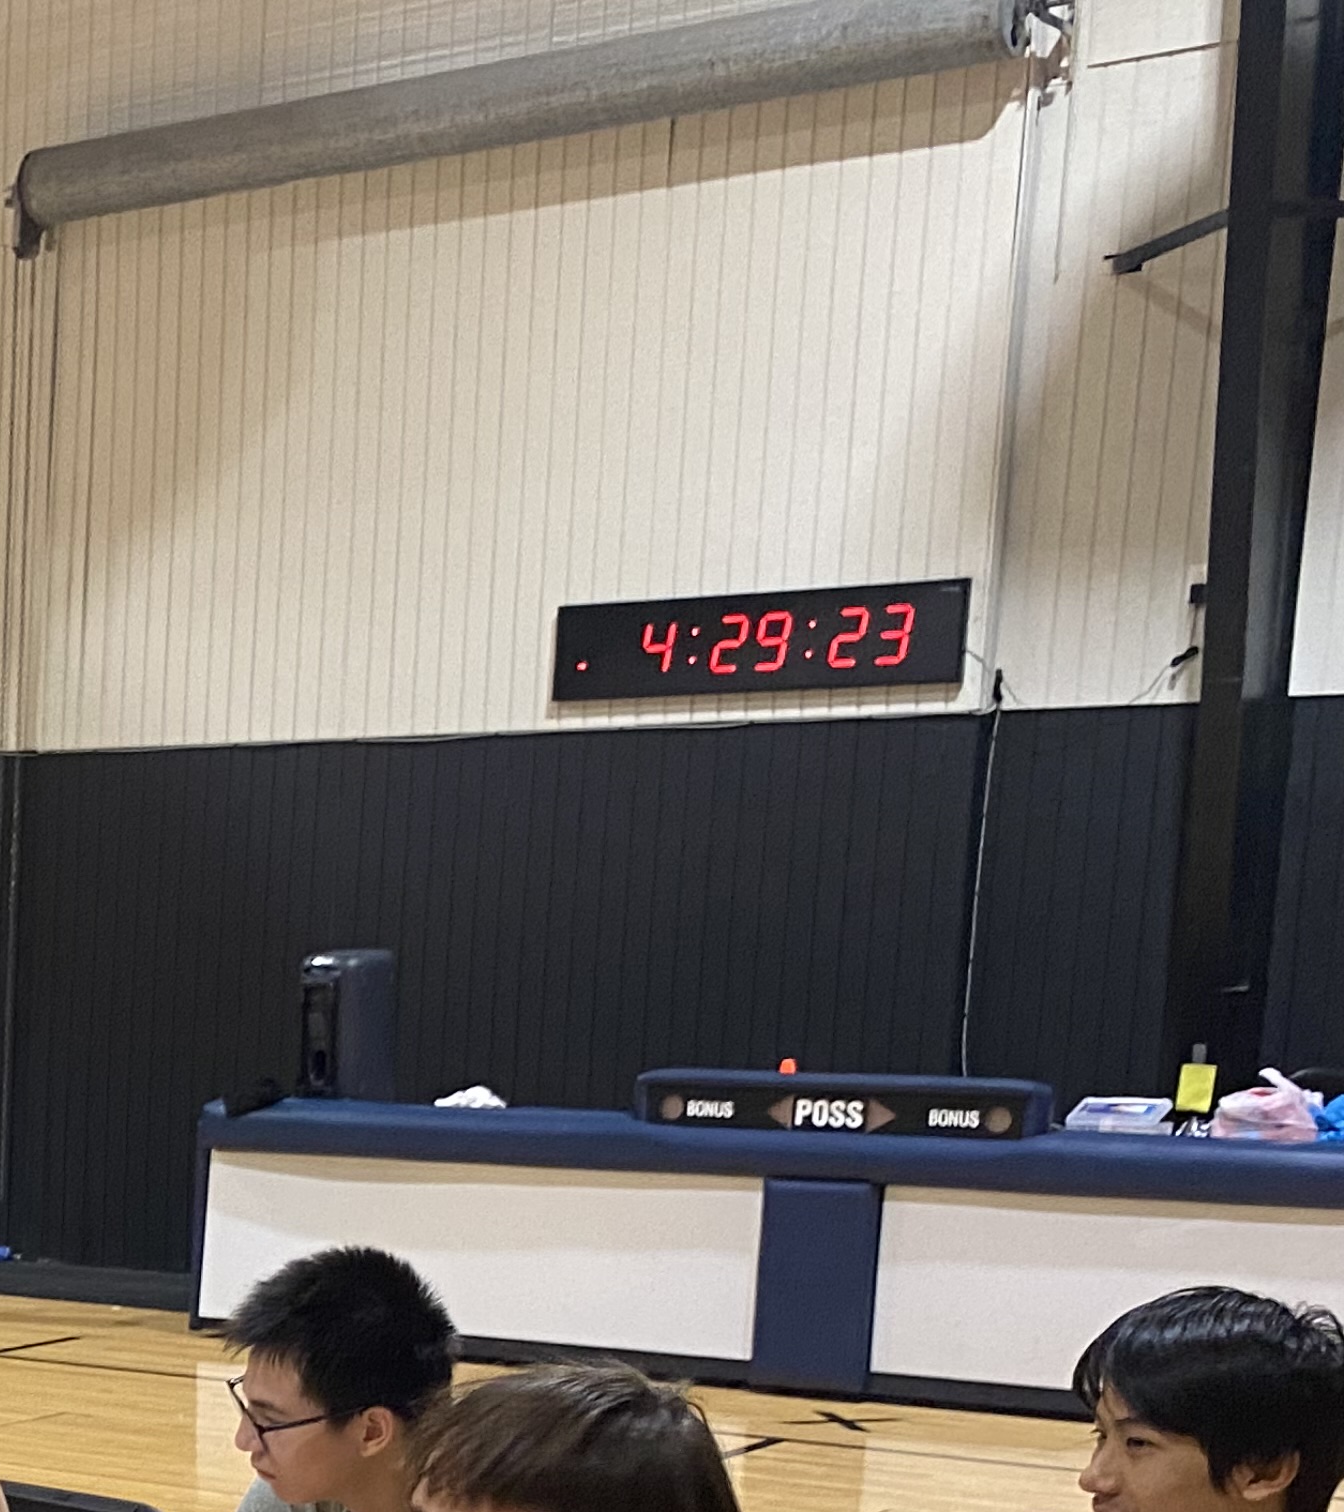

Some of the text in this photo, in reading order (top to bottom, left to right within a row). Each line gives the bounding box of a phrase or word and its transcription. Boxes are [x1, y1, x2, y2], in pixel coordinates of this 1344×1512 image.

[642, 602, 916, 674] 4:29:23
[686, 1099, 735, 1119] BONUS
[794, 1098, 864, 1129] POSS
[927, 1108, 980, 1130] BONUS
